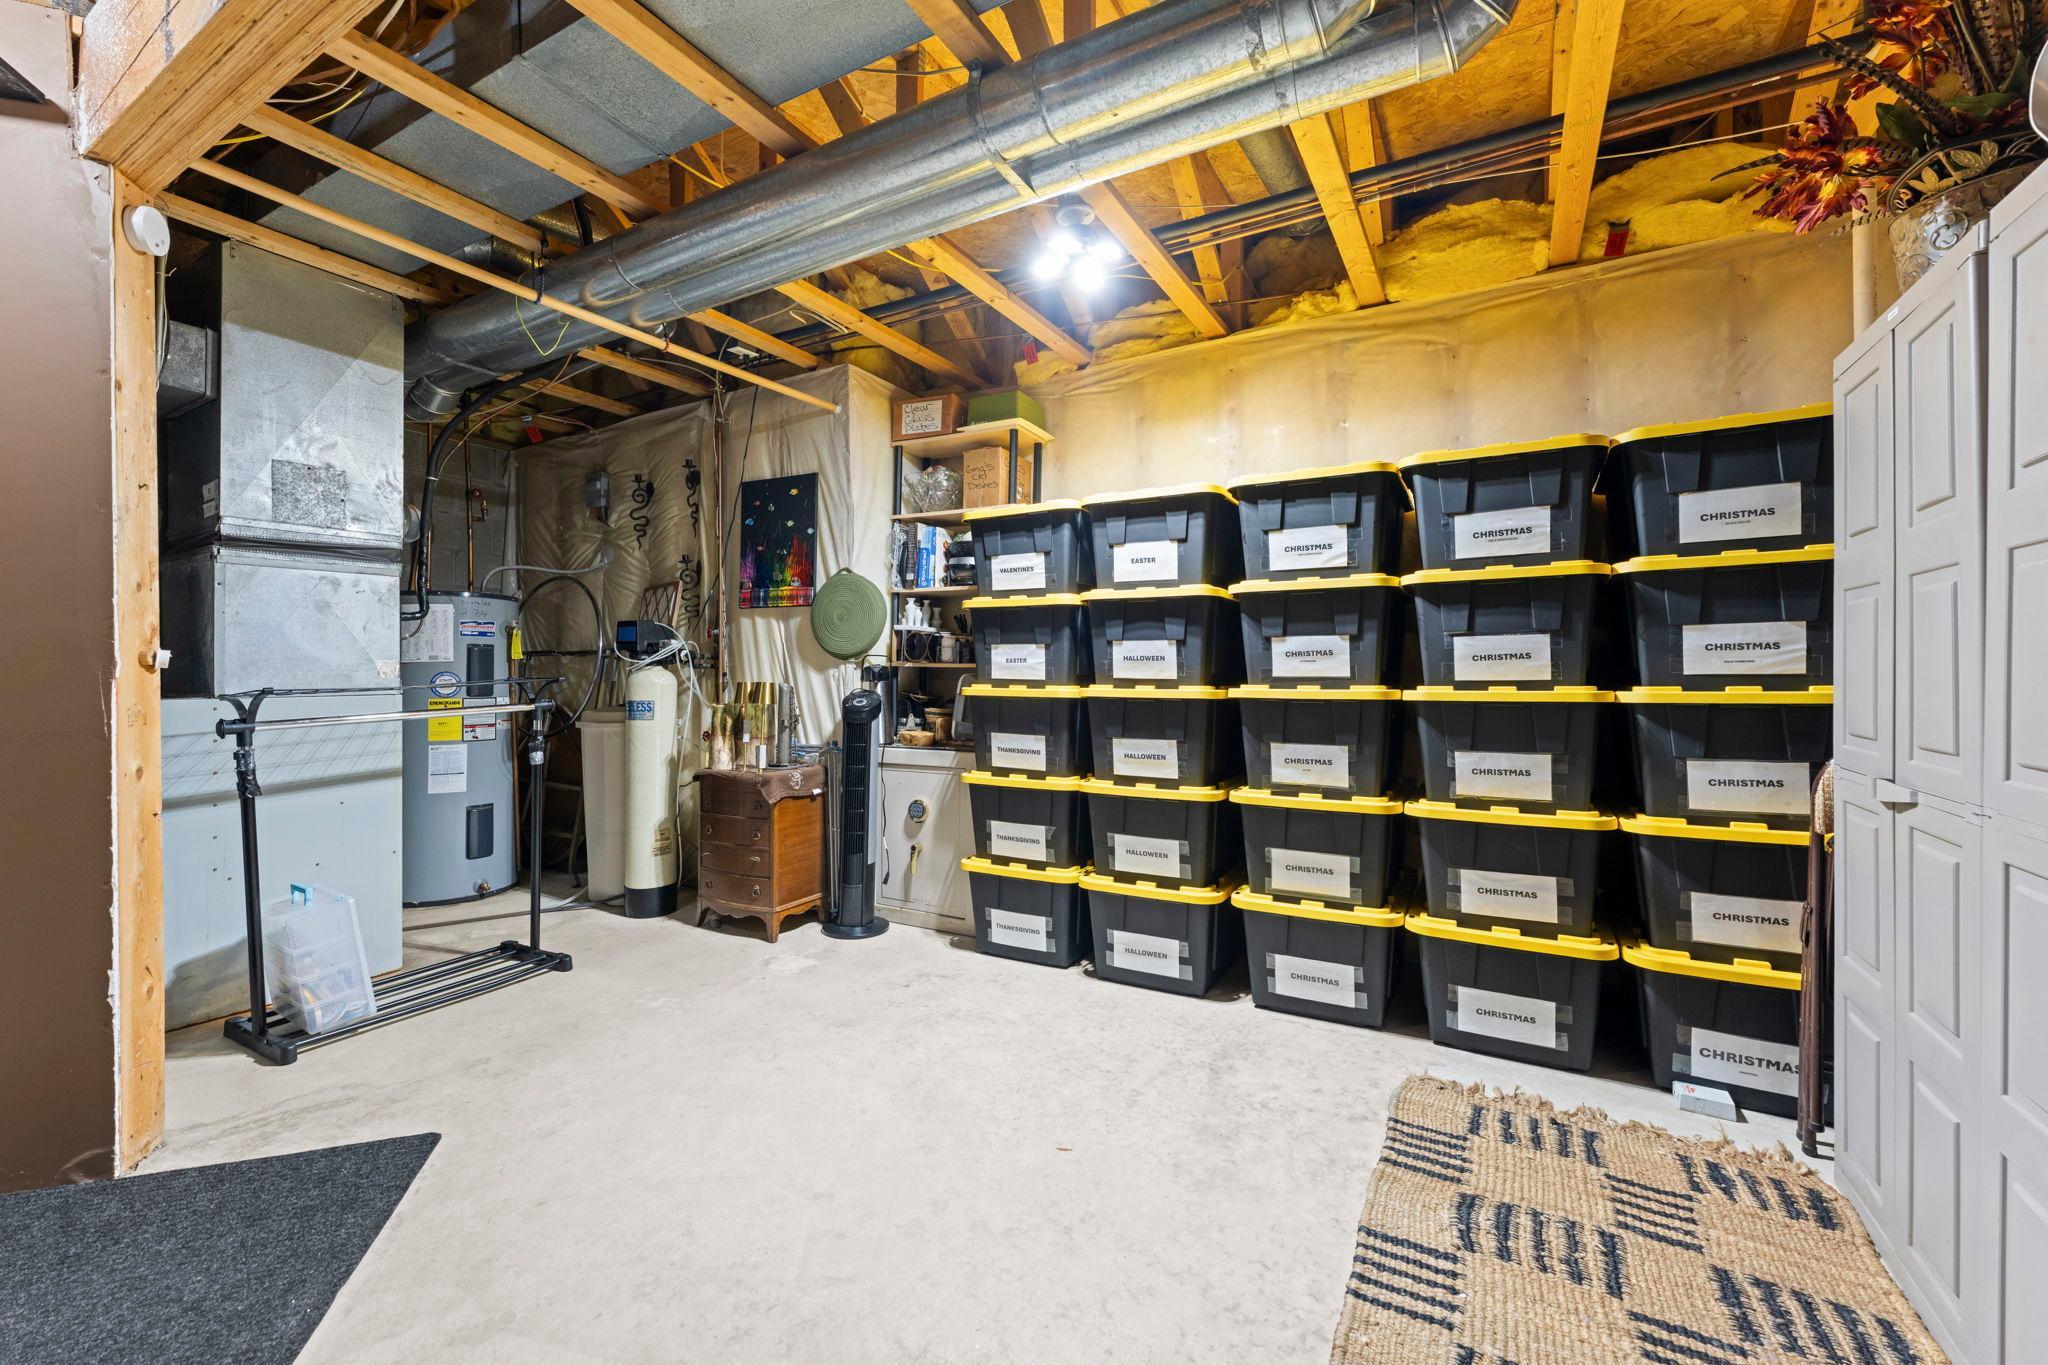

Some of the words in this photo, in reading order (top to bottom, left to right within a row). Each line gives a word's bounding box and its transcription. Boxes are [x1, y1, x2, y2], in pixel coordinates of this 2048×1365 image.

[904, 403, 935, 414] Clear
[904, 414, 935, 424] Glass
[1700, 507, 1776, 522] CHRISTMAS
[1472, 526, 1533, 539] CHRISTMAS
[1284, 542, 1333, 554] CHRISTMAS
[999, 565, 1035, 575] VALENTINES
[1704, 641, 1781, 652] CHRISTMAS
[1285, 649, 1334, 658] CHRISTMAS
[1471, 652, 1532, 662] CHRISTMAS
[996, 746, 1041, 756] THANKSGIVING
[1123, 752, 1167, 761] HALLOWEEN
[1284, 757, 1333, 766] CHRISTMAS
[1471, 768, 1532, 777] CHRISTMAS
[1708, 778, 1785, 788] CHRISTMAS
[996, 834, 1041, 845] THANKSGIVING
[1125, 848, 1169, 859] HALLOWEEN
[1285, 864, 1334, 876] CHRISTMAS
[1477, 886, 1538, 899] CHRISTMAS
[1712, 912, 1790, 927] CHRISTMAS
[995, 922, 1041, 935] THANKSGIVING
[1124, 947, 1168, 960] HALLOWEEN
[1290, 972, 1340, 987] CHRISTMAS
[1475, 1007, 1537, 1025] CHRISTMAS
